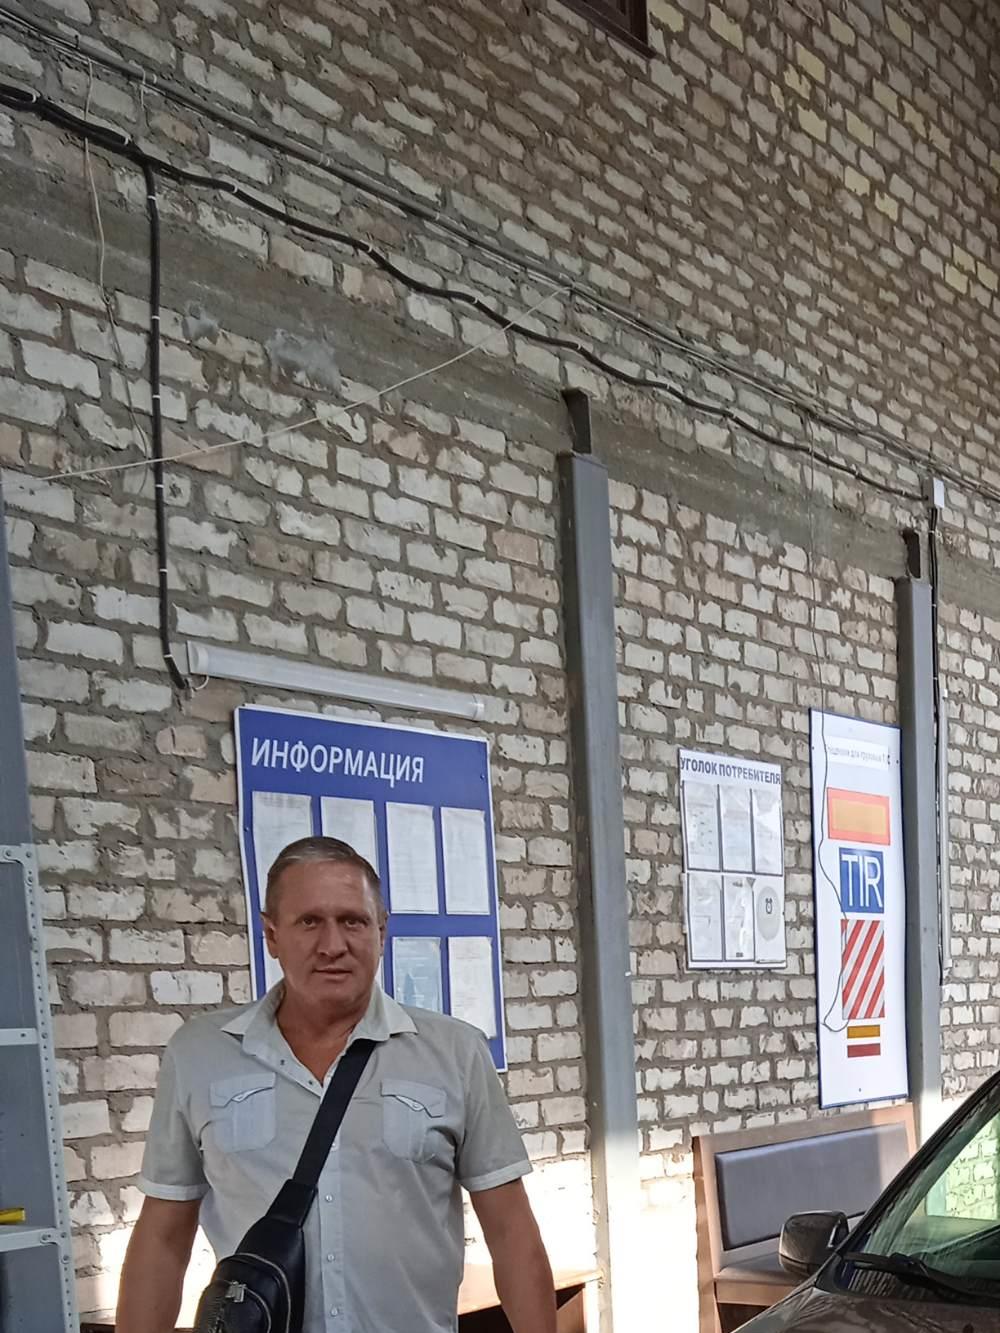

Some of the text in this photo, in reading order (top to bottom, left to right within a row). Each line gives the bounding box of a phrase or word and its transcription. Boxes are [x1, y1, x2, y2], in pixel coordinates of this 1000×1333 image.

[251, 737, 424, 789] ИНФОРМАЦИЯ
[680, 757, 781, 785] УГОЛОК ПОТРЕБИТЕЛЯ
[841, 853, 884, 908] TIR
